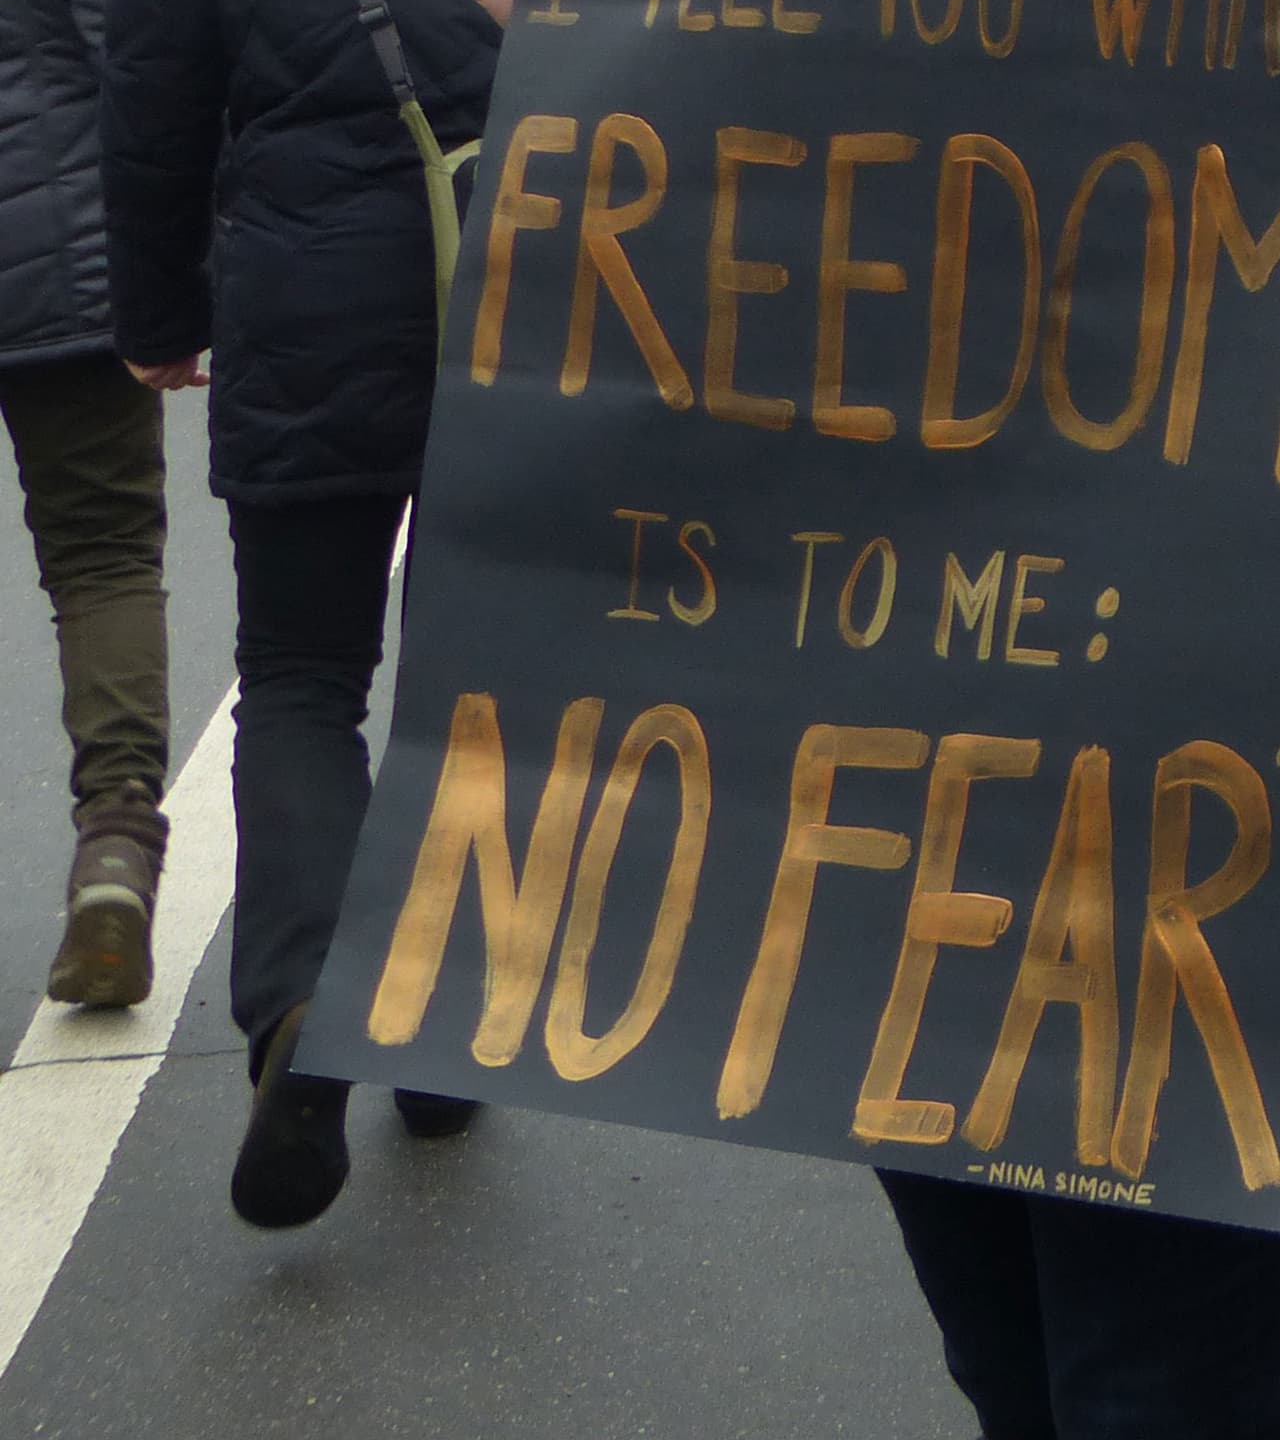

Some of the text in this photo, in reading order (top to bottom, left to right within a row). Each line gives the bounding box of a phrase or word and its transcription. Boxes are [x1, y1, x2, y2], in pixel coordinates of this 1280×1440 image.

[607, 509, 1120, 667] IS TO ME:
[368, 693, 711, 1081] NO
[1055, 1171, 1156, 1205] SIMONE
